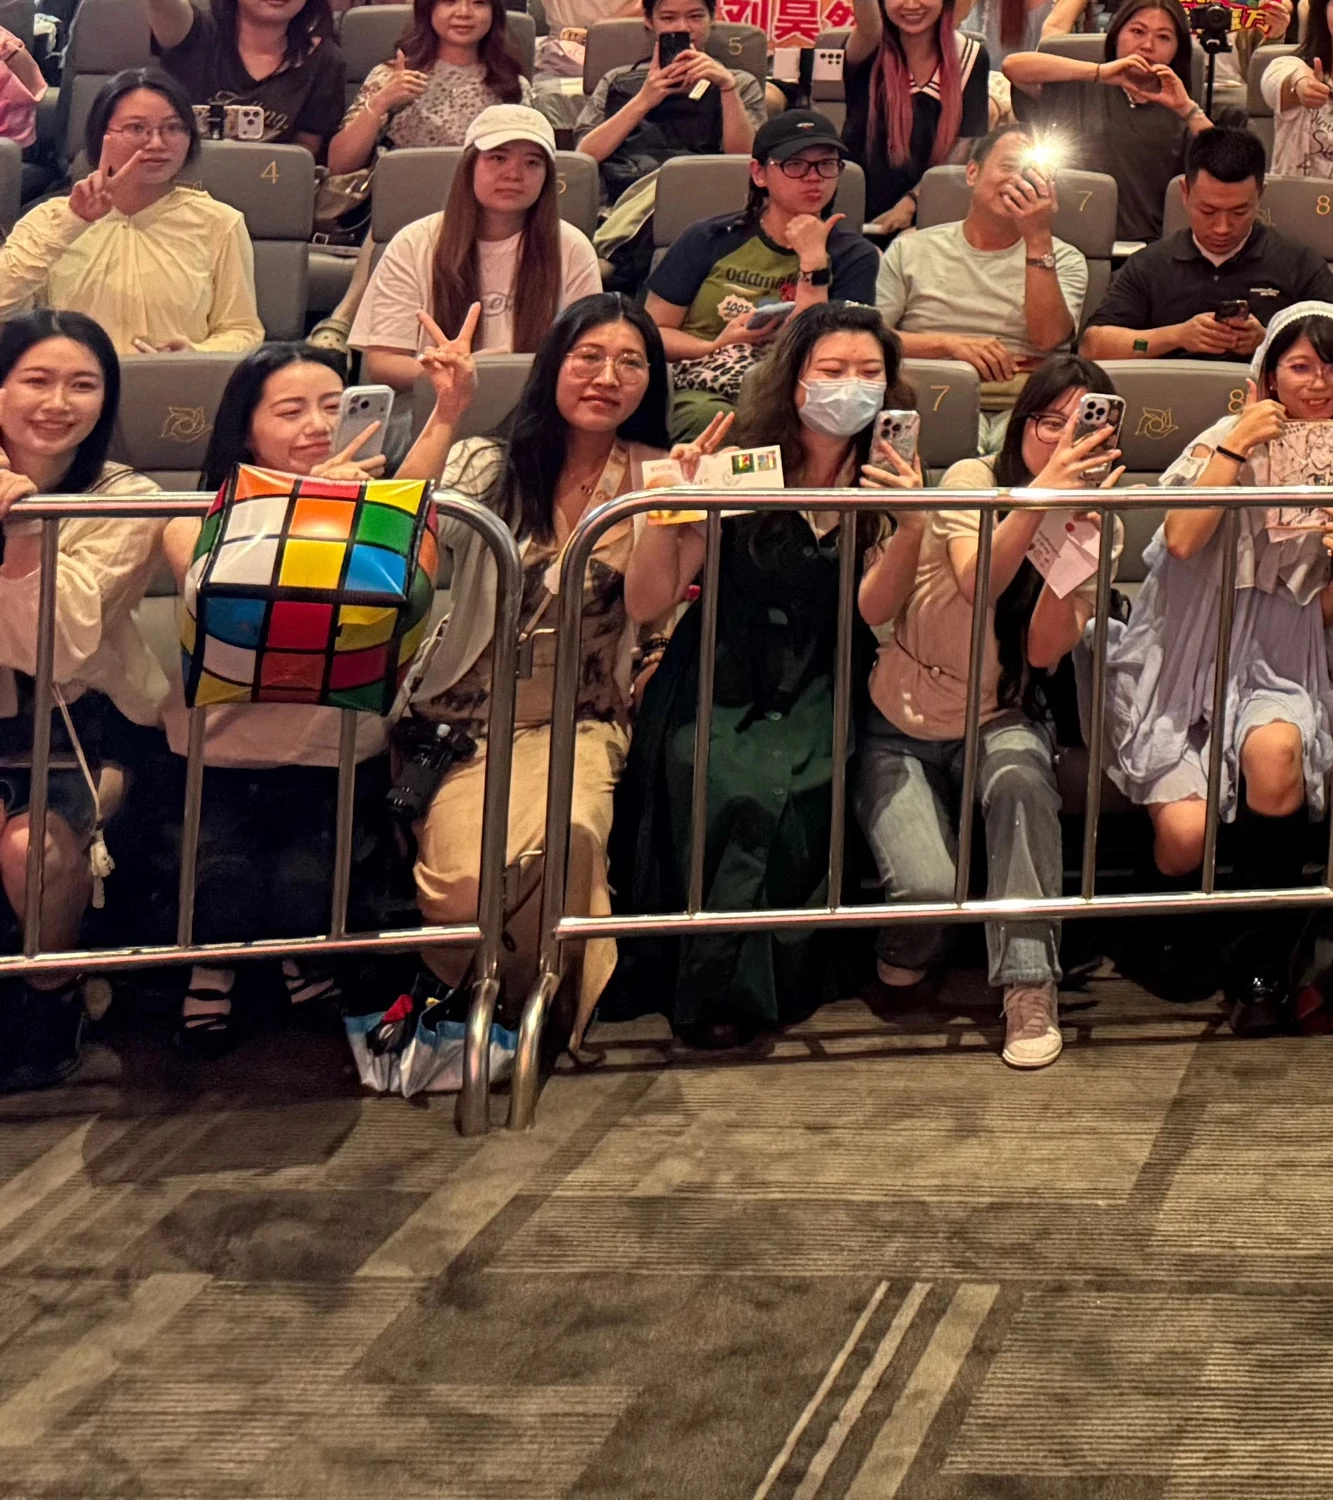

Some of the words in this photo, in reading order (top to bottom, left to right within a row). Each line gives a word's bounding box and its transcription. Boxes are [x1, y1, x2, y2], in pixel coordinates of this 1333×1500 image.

[728, 37, 743, 56] 5
[260, 161, 279, 184] 4
[1077, 191, 1093, 211] 7
[1316, 195, 1331, 215] 8
[931, 386, 950, 412] 7
[1228, 389, 1244, 413] 8
